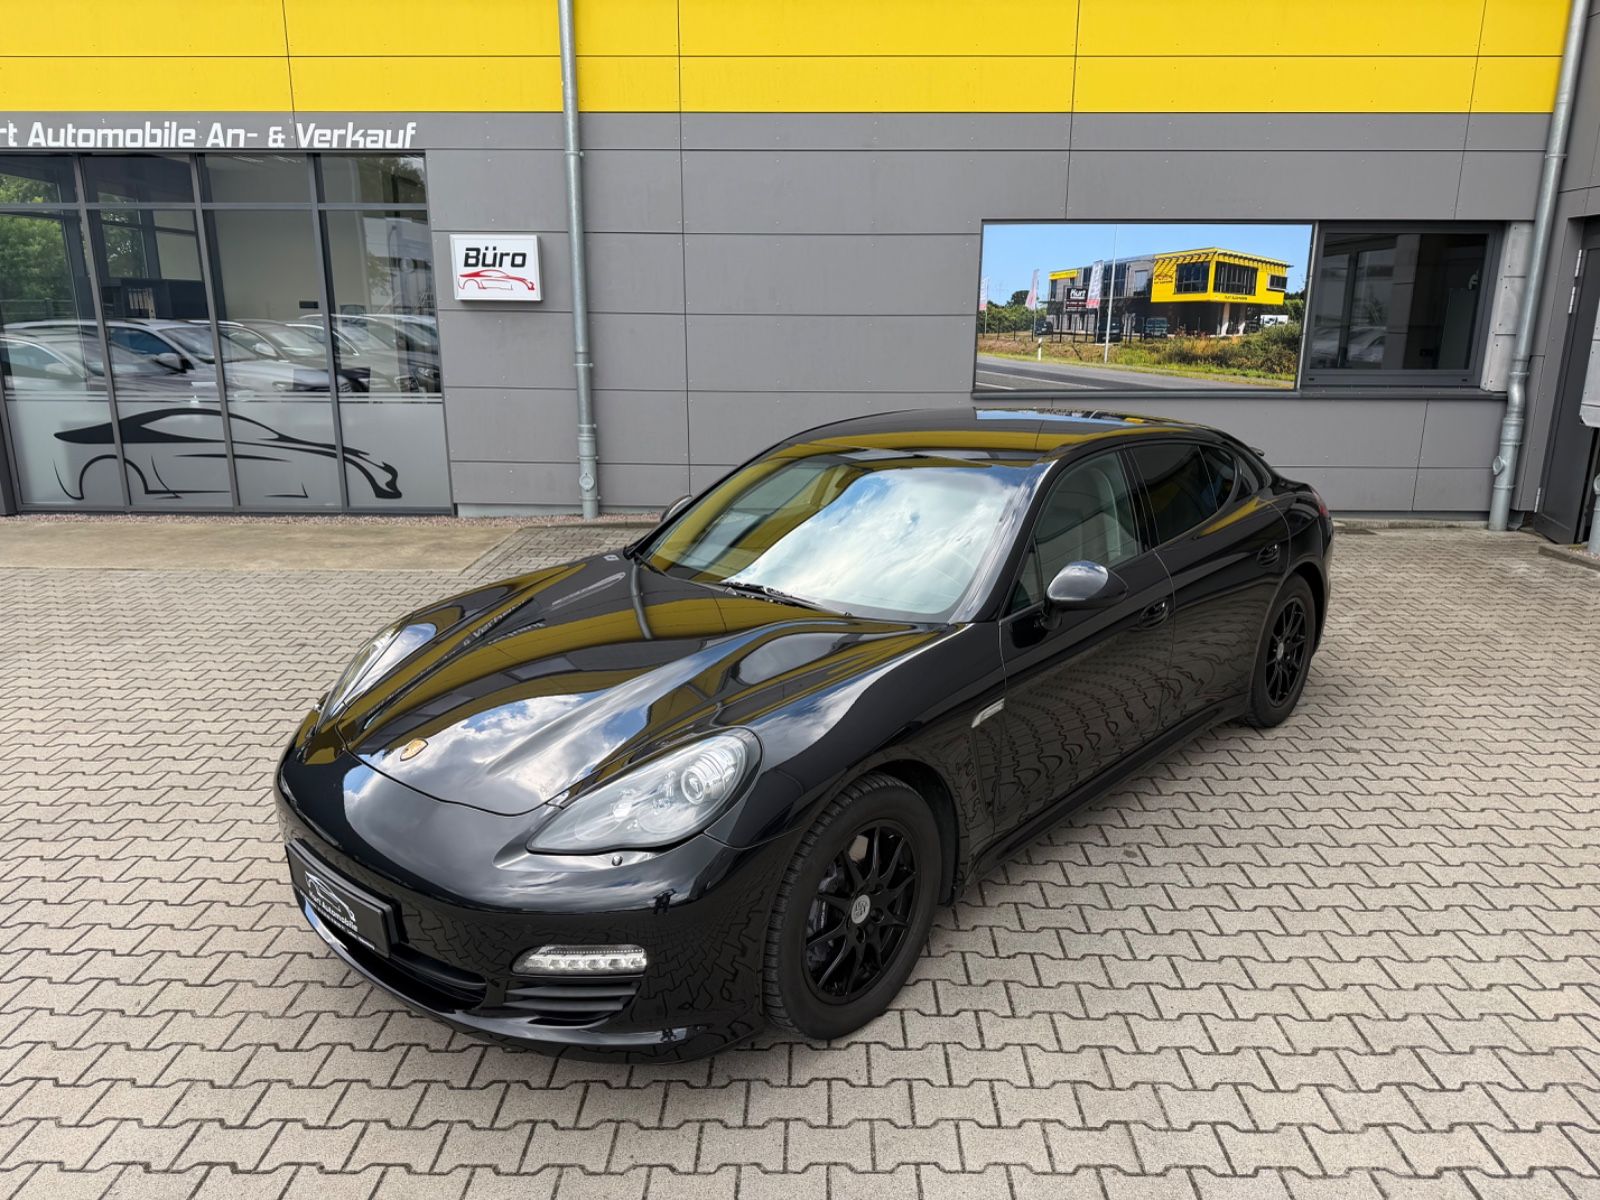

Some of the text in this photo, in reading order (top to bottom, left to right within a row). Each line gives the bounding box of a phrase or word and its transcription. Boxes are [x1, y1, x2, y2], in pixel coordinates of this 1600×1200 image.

[27, 121, 196, 148] Automobile
[206, 122, 258, 148] An-
[268, 126, 286, 148] &
[296, 122, 416, 148] Verkauf
[463, 246, 527, 268] Büro
